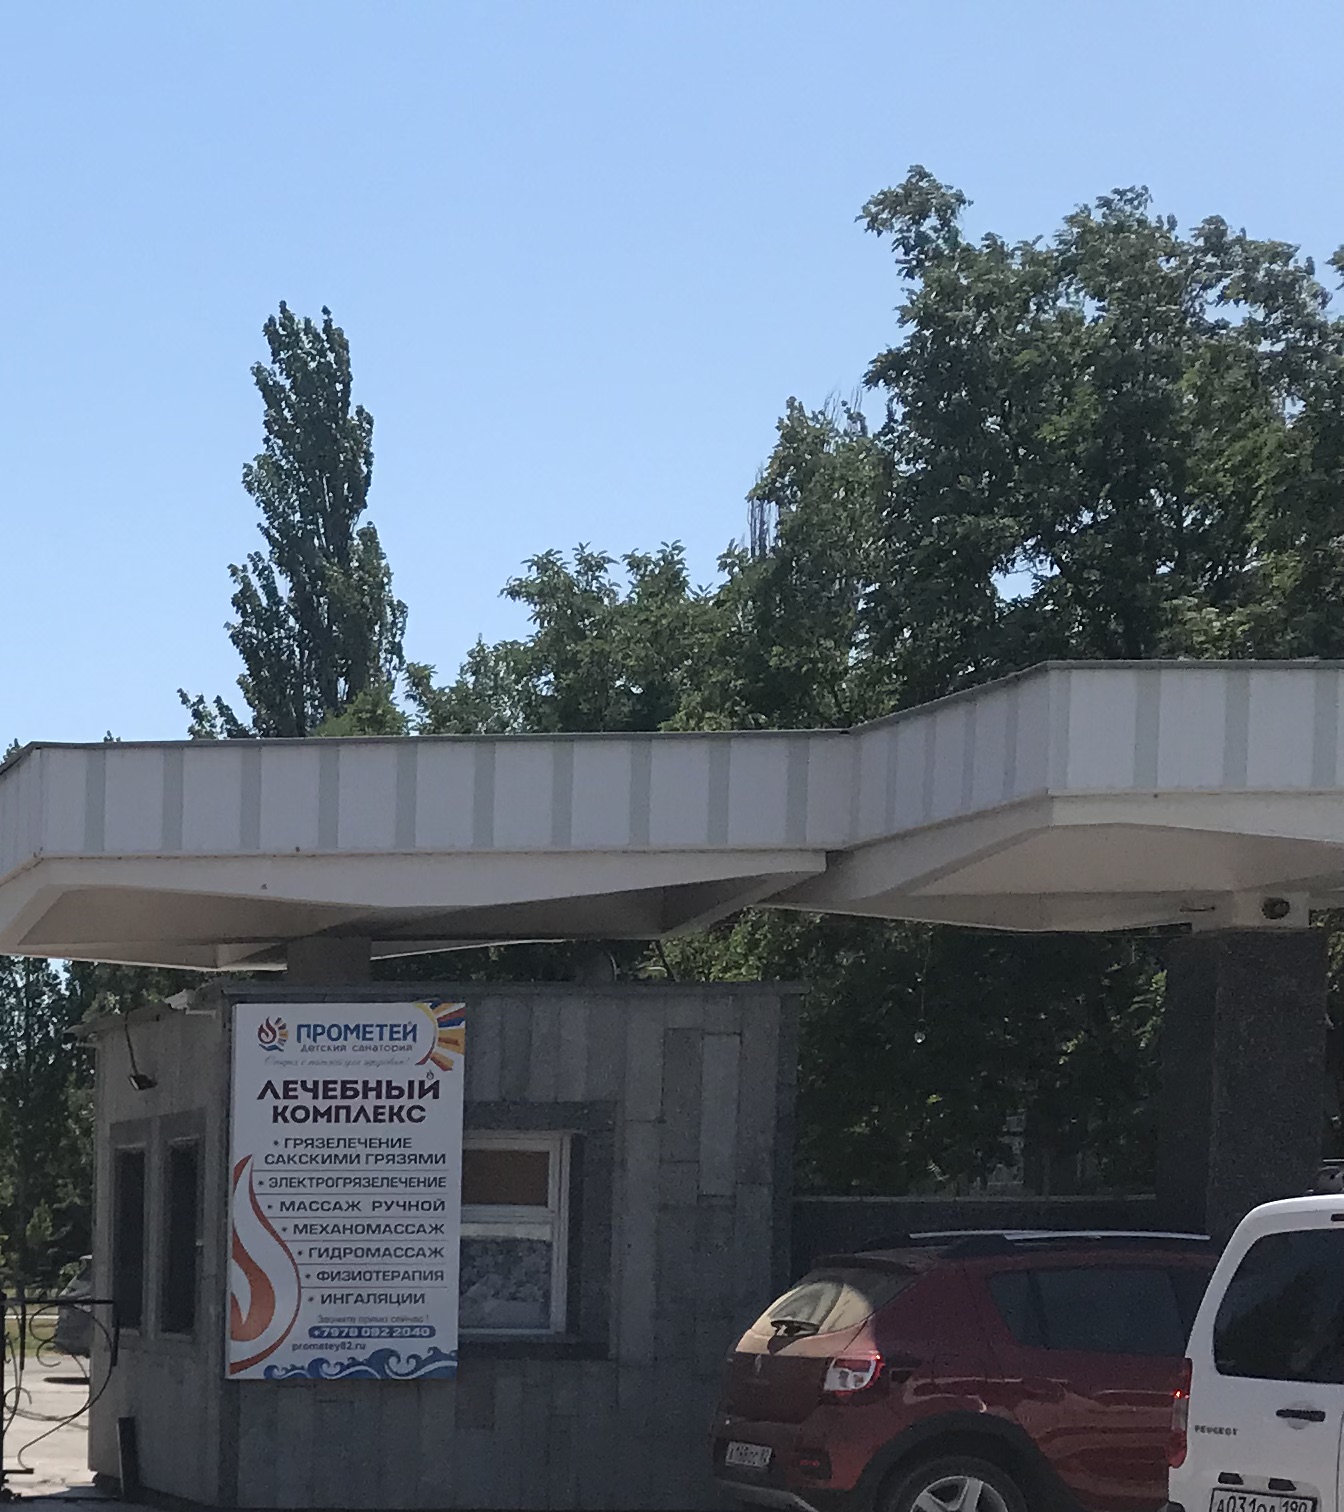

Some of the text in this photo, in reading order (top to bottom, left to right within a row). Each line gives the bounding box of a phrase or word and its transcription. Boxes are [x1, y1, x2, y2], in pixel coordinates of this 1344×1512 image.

[296, 1022, 418, 1043] ПРОМЕТЕЙ
[352, 1044, 413, 1053] санаторий
[257, 1076, 440, 1100] ЛЕЧЕБНЫЙ
[272, 1104, 427, 1124] КОМПЛЕКС
[284, 1137, 413, 1149] ГРЯЗЕЛЕЧЕНИЕ
[264, 1153, 446, 1165] САКСКИМИ ГРЯЗЯМИ
[268, 1176, 447, 1188] ЭЛЕКТРОГРЯЗЕЛЕЧЕНИЕ
[279, 1199, 446, 1212] МАССАЖ РУЧНОЙ
[293, 1223, 445, 1235] МЕХАНОМАССАЖ
[308, 1247, 445, 1260] ГИДРОМАССАЖ
[316, 1270, 444, 1282] ФИЗИОТЕРАПИЯ
[320, 1293, 425, 1306] ИНГАЛЯЦИИ
